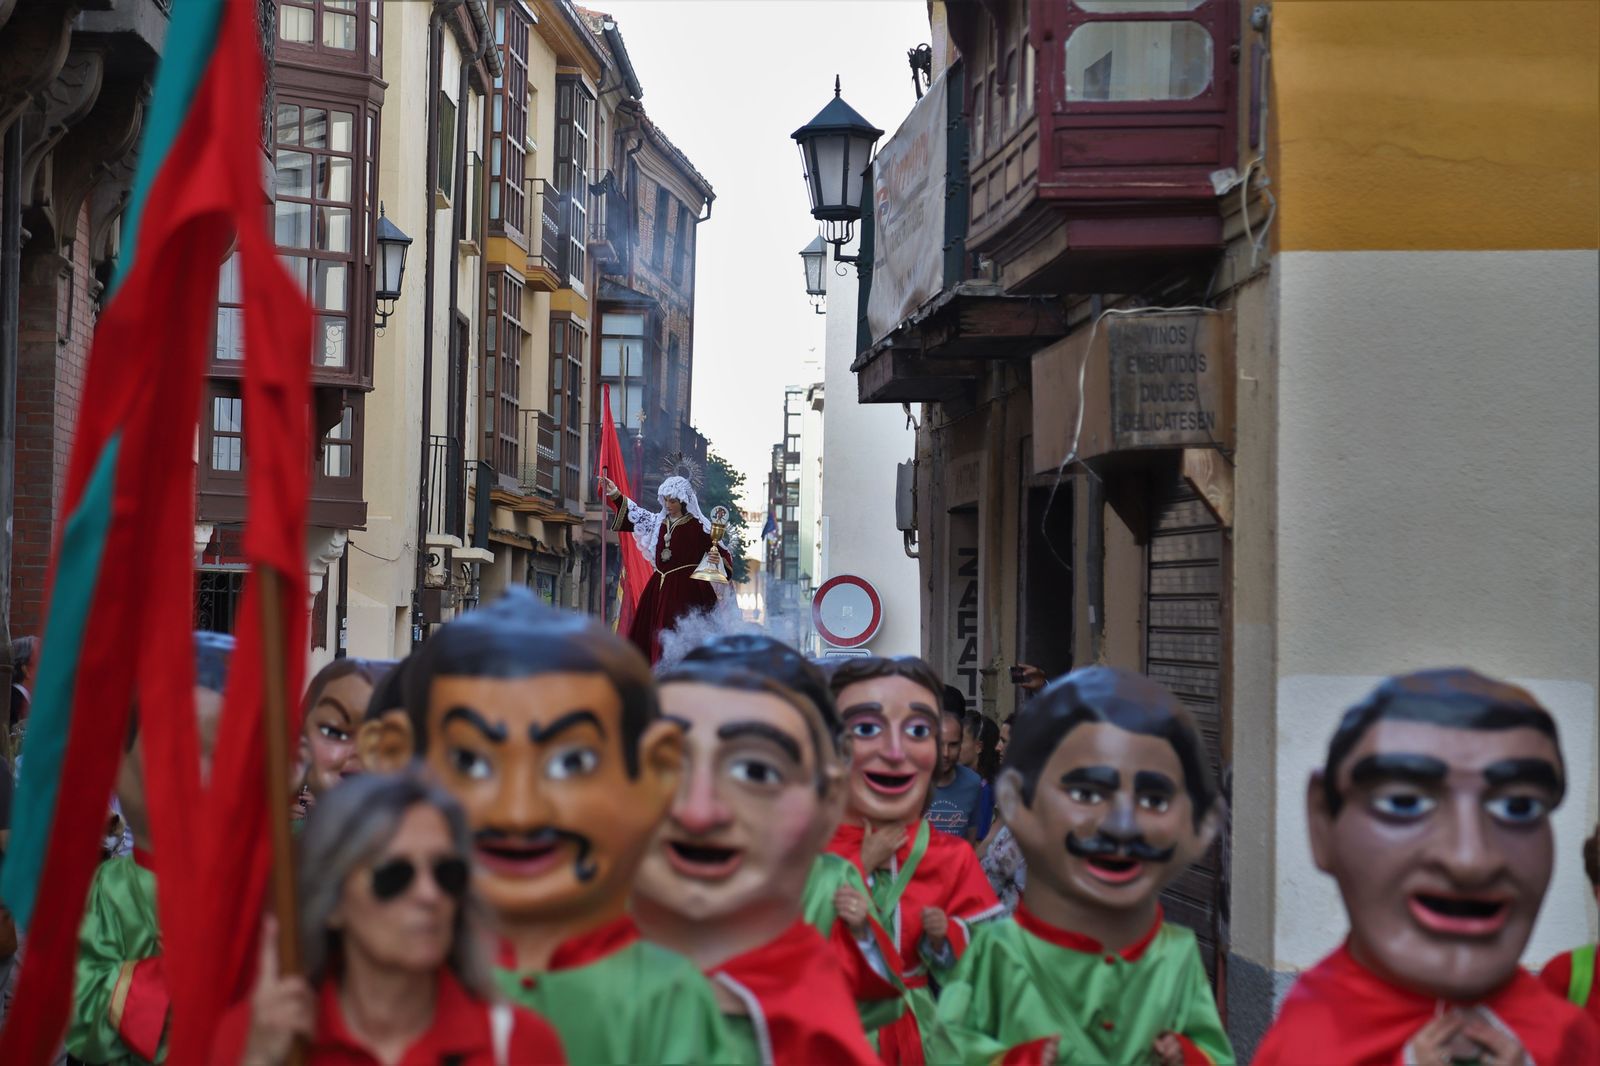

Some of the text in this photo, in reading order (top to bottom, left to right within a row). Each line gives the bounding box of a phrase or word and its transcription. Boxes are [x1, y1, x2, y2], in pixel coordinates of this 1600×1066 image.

[1147, 326, 1187, 346] VINOS
[1128, 355, 1206, 375] EMBUTIDOS
[1140, 383, 1195, 402] DULCES
[1121, 412, 1215, 431] DELICATESEN
